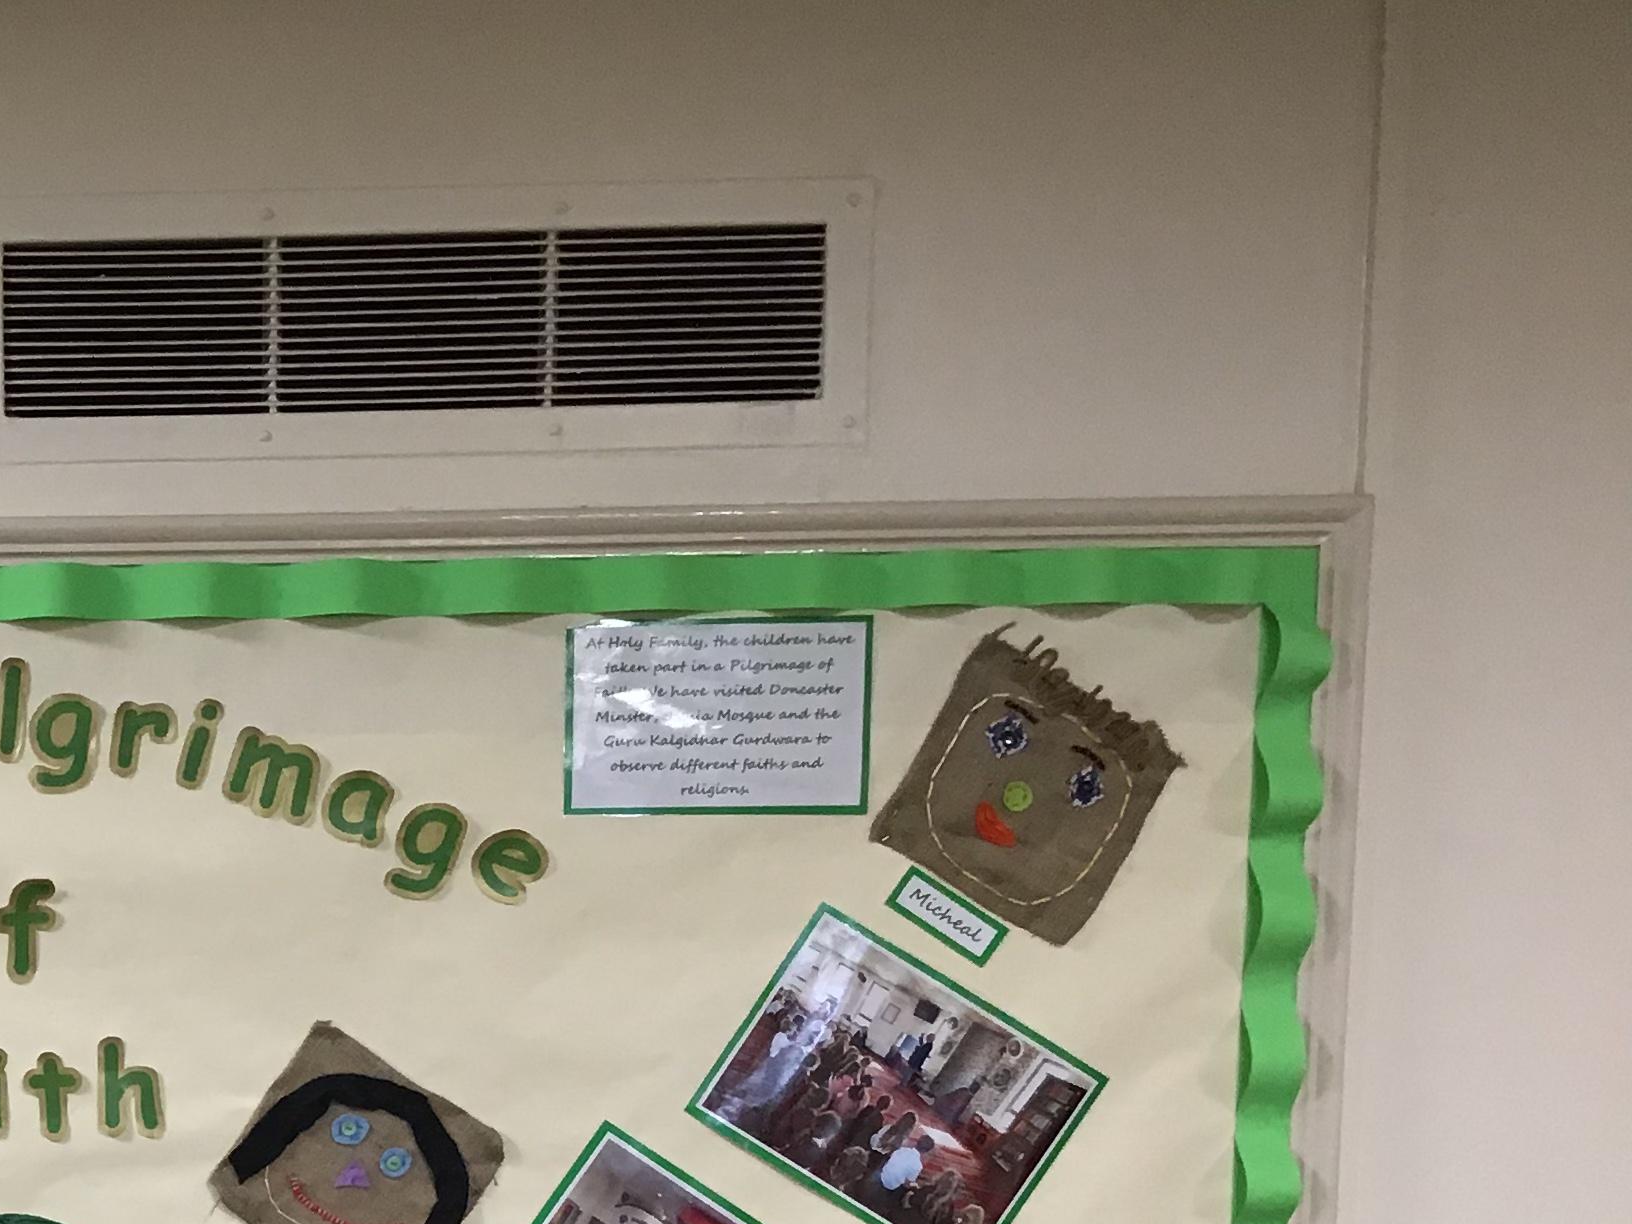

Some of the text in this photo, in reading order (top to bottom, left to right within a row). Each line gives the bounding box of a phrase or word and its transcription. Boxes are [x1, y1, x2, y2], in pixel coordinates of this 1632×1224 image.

[585, 637, 605, 649] At
[608, 636, 643, 651] Holy
[713, 635, 739, 647] the
[744, 634, 813, 646] children
[818, 633, 855, 645] have
[605, 657, 835, 675] taken part in a Pilgrimage of
[671, 685, 710, 697] have
[714, 684, 765, 696] visited
[770, 683, 844, 695] Doncaster
[718, 709, 775, 722] Mosque
[779, 708, 810, 720] and
[814, 708, 841, 719] the
[604, 735, 646, 747] Guru
[732, 733, 812, 746] Gurdwara
[816, 733, 832, 744] to
[610, 757, 824, 773] observe different faiths and
[681, 783, 750, 797] religions.
[909, 888, 982, 942] Micheal
